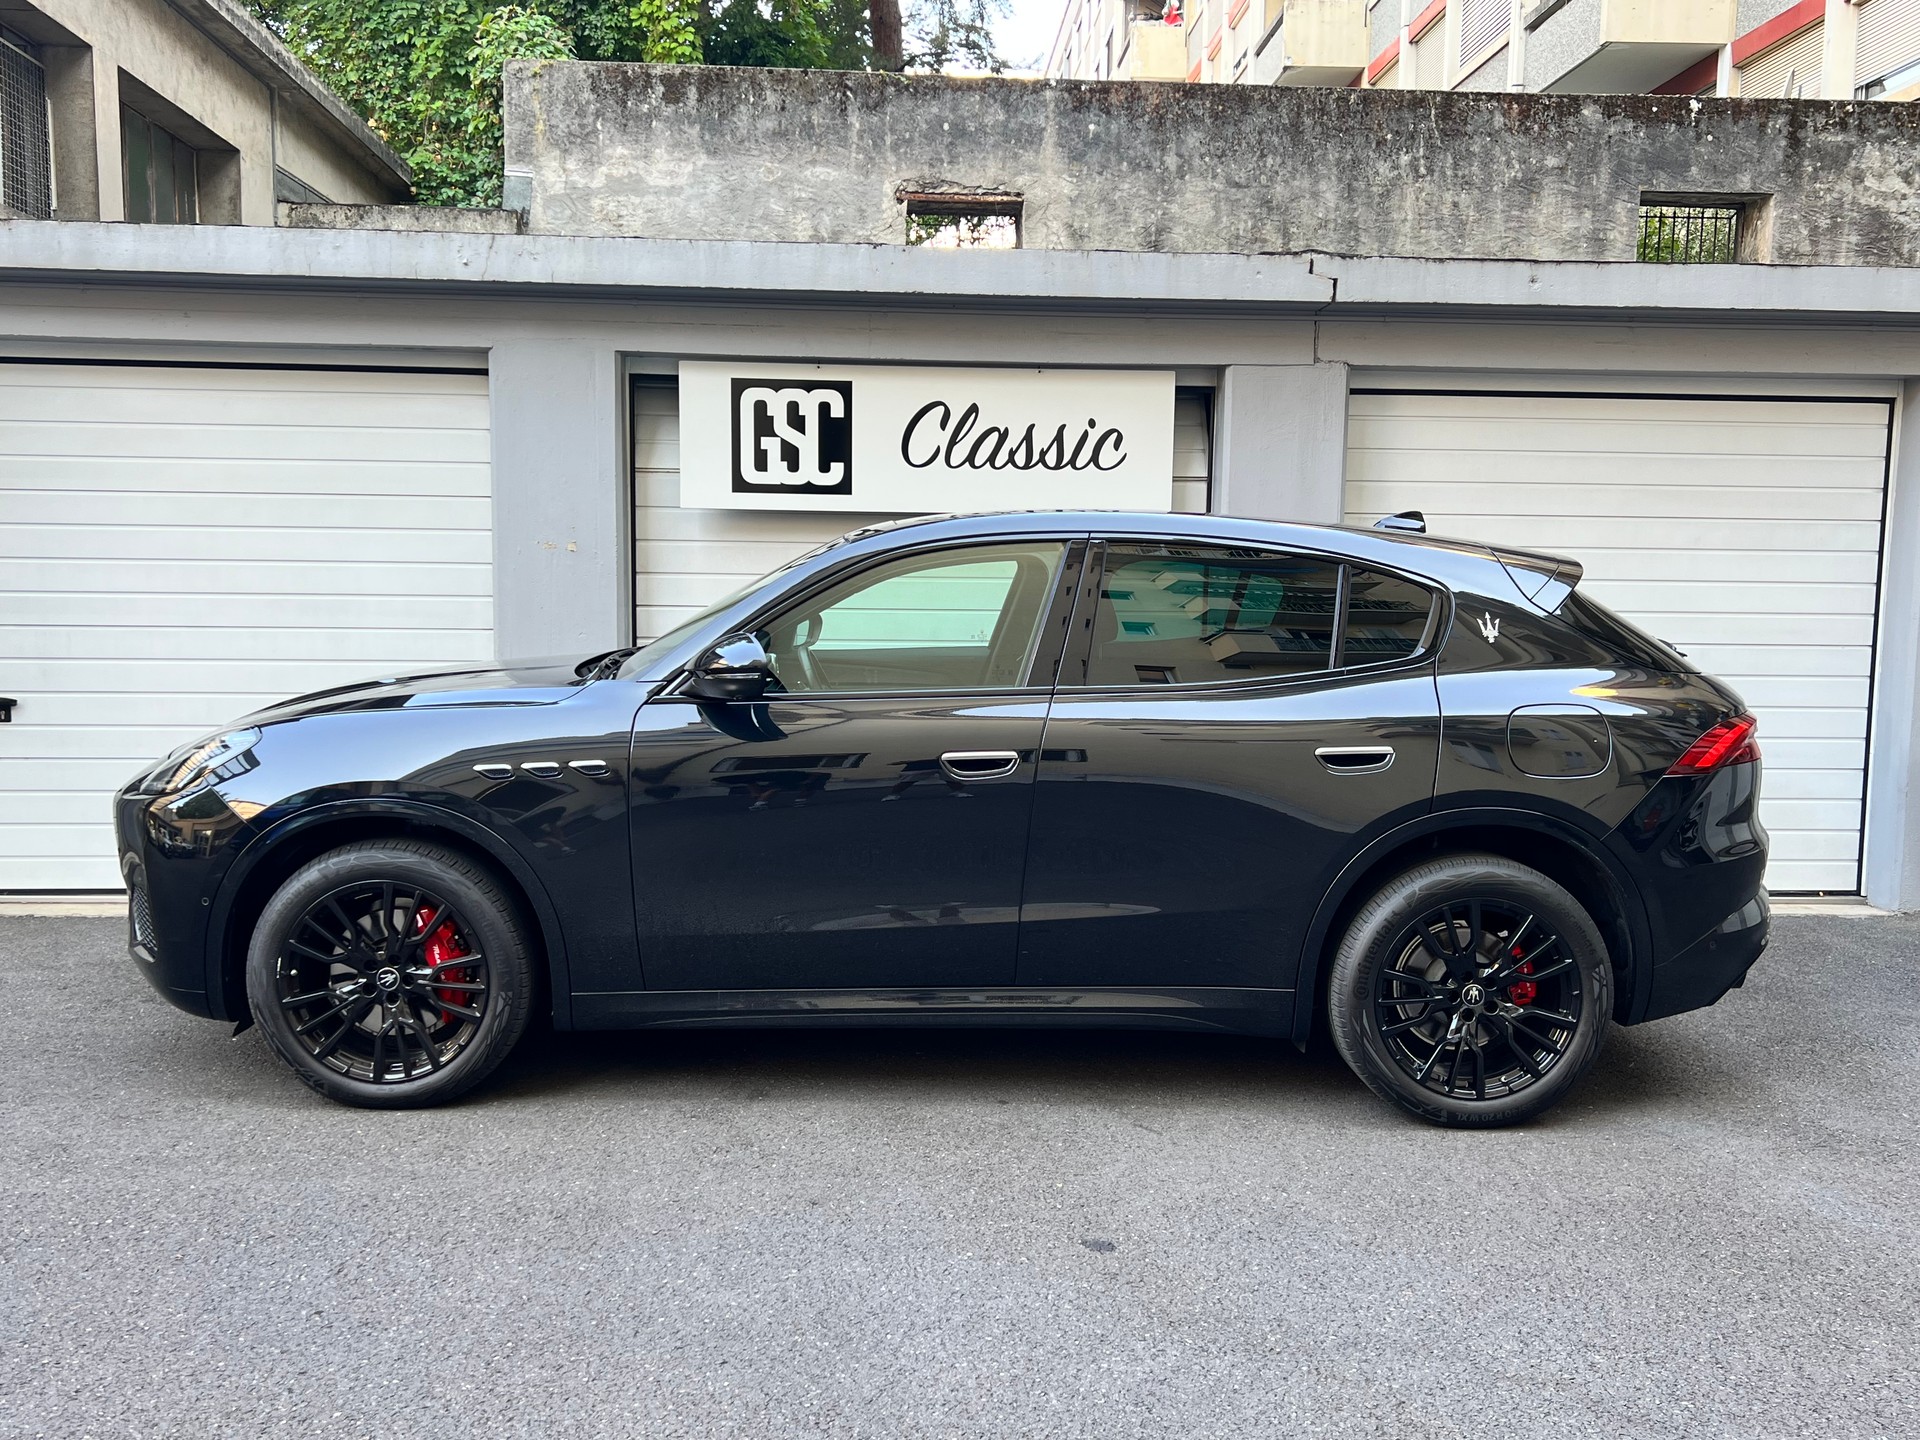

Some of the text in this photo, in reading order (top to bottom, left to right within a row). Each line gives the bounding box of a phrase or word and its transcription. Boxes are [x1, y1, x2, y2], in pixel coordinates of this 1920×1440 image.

[740, 387, 1127, 486] GSC Classic
[1353, 917, 1395, 1001] Continental
